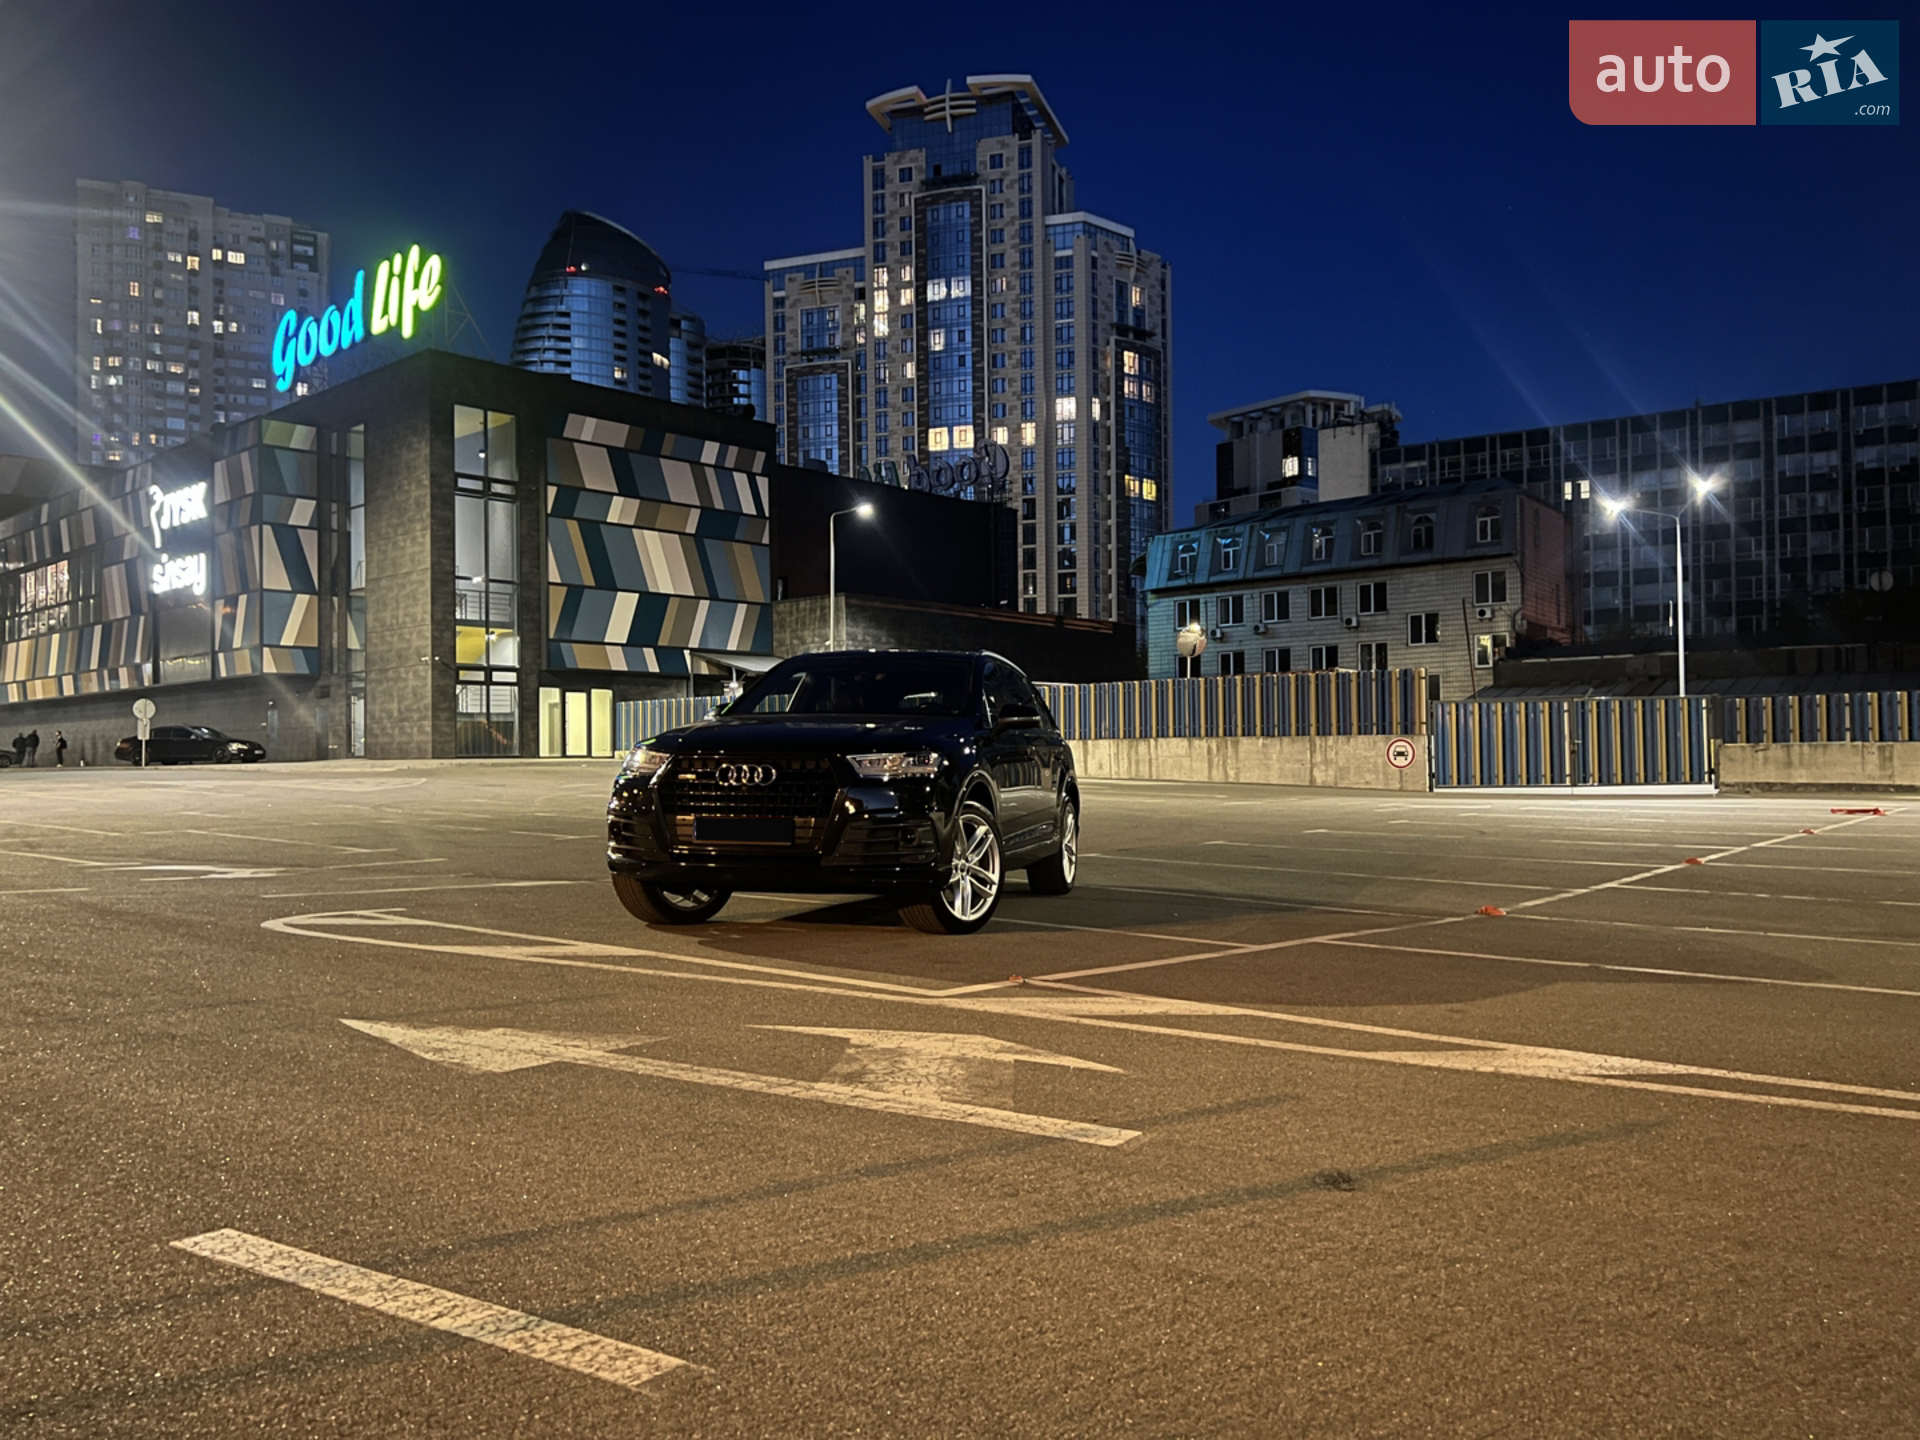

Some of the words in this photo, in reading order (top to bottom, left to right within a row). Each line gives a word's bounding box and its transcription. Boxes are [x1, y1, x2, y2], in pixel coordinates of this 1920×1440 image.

[271, 268, 365, 393] Good
[370, 243, 442, 340] Life
[160, 481, 208, 530] JYSK
[152, 552, 207, 596] sinsay
